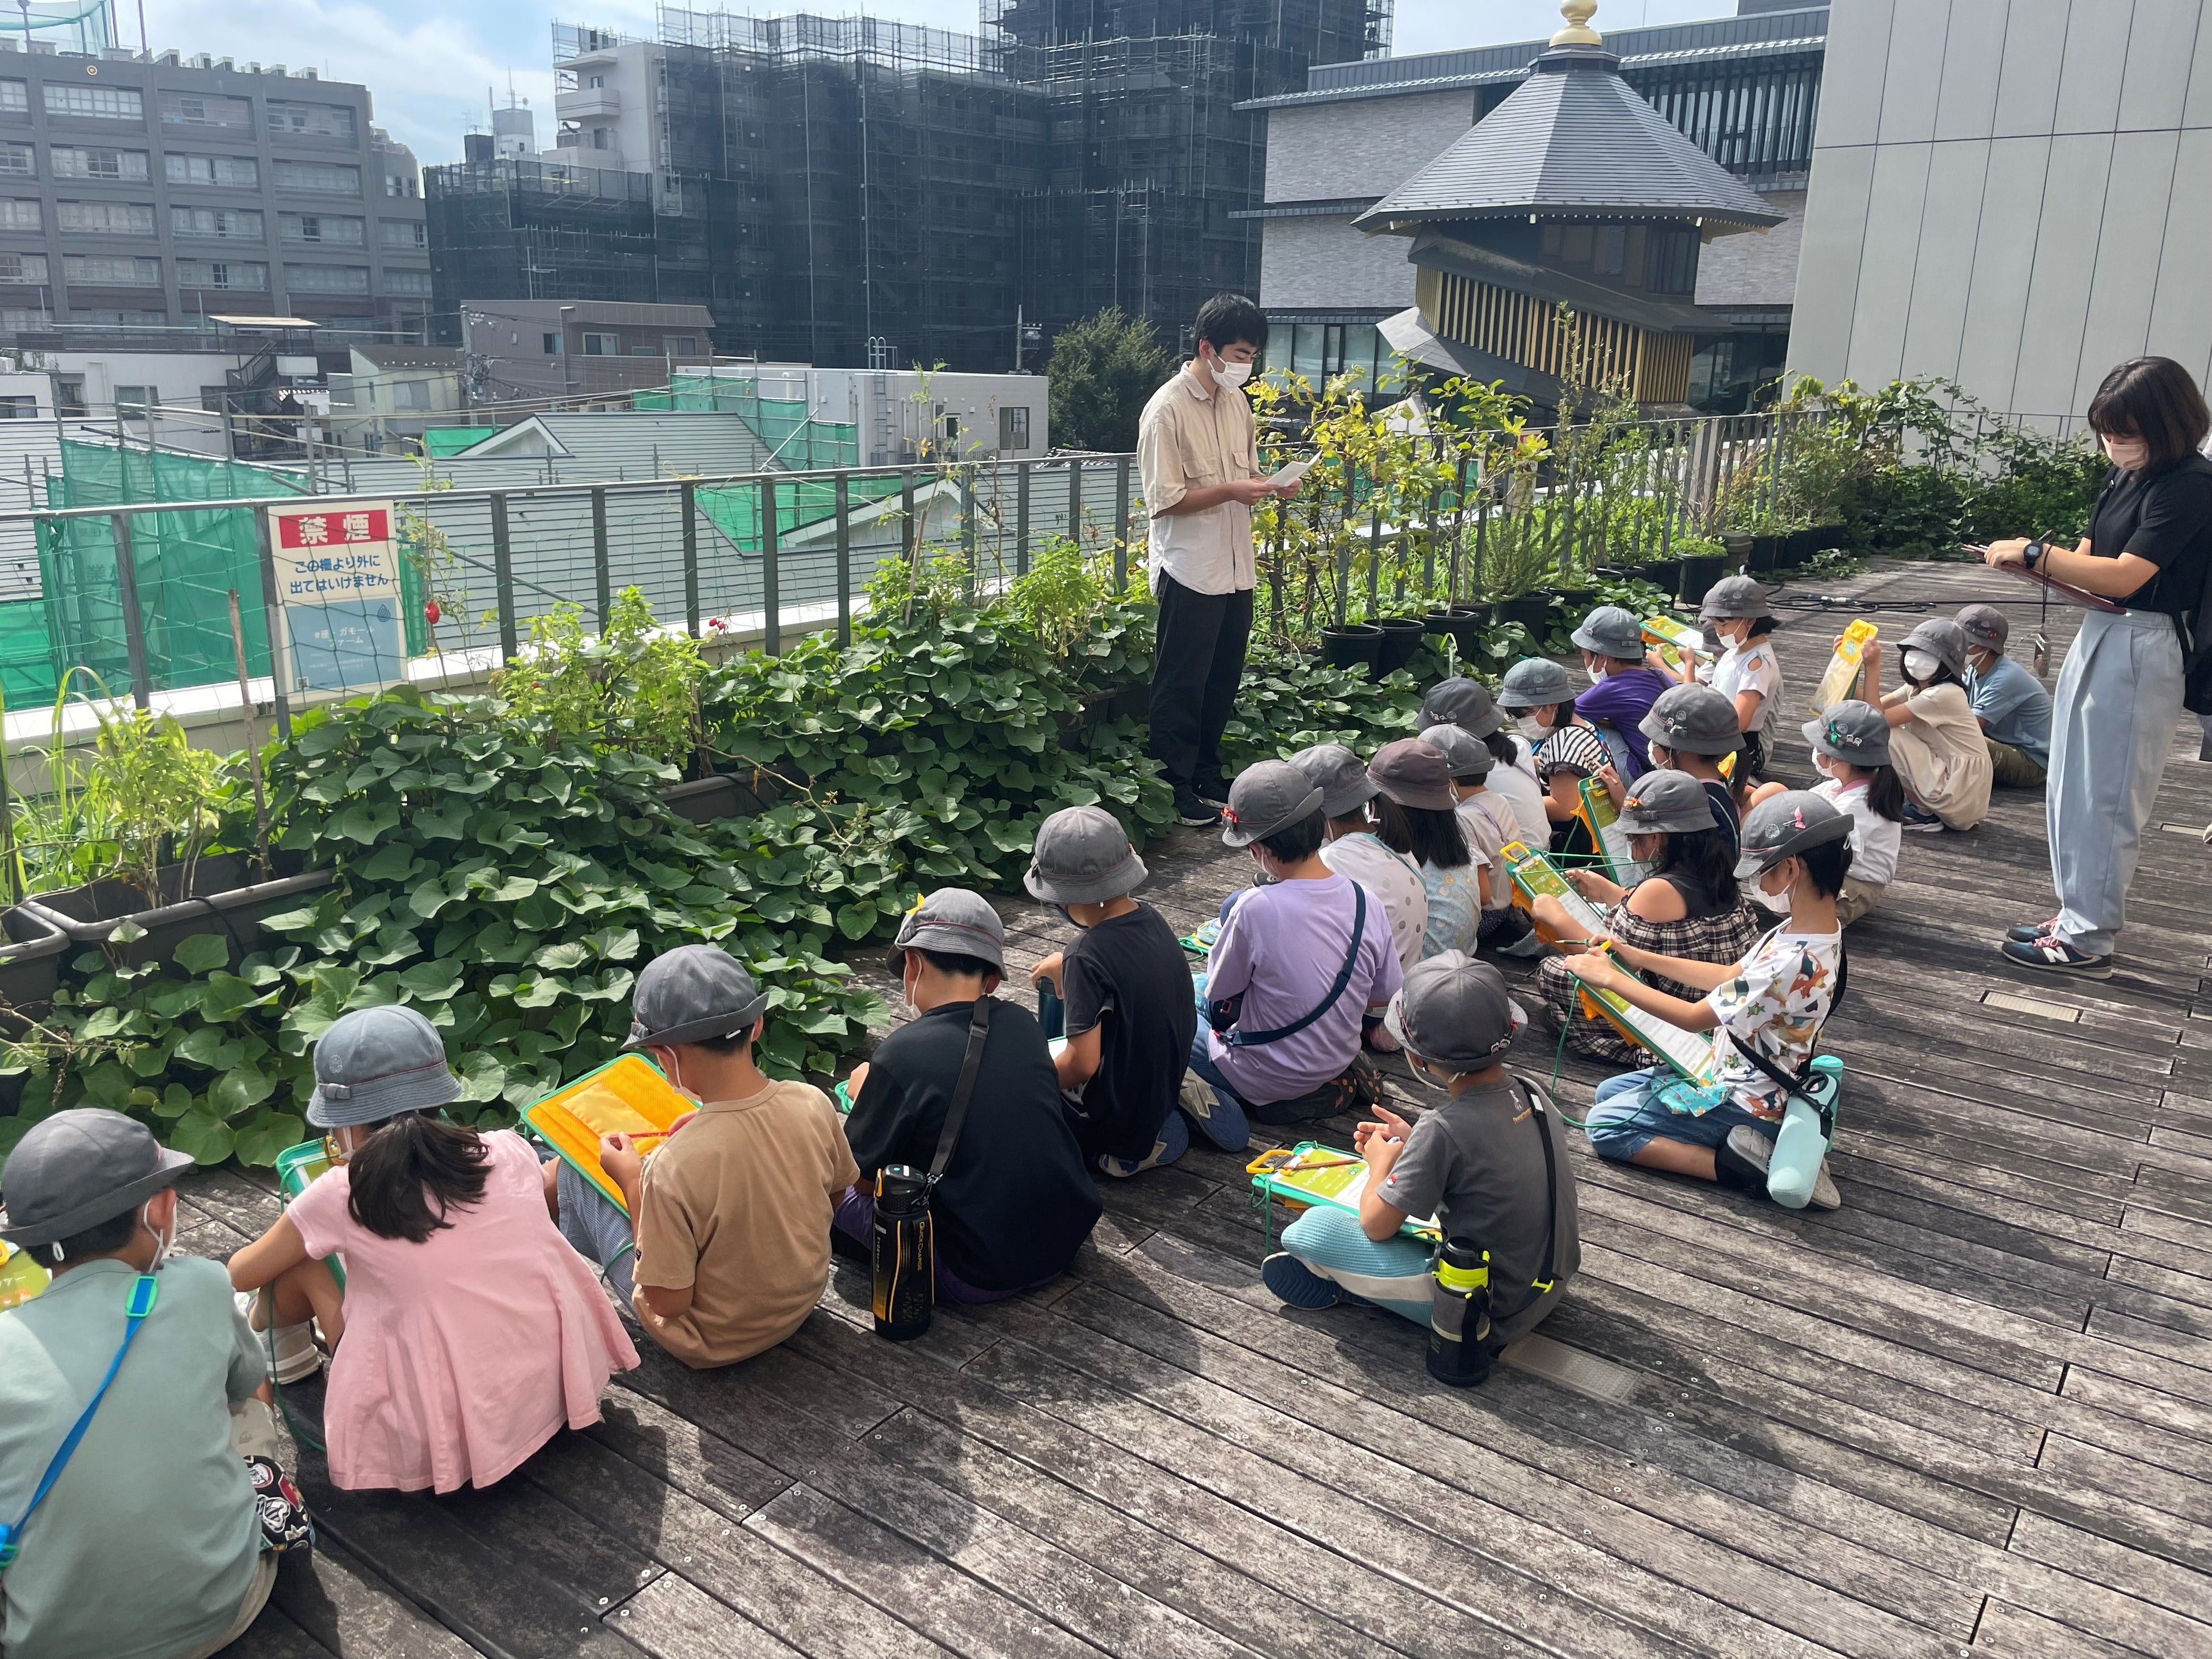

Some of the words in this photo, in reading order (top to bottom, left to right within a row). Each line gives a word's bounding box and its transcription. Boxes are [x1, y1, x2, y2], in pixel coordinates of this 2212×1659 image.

[299, 514, 371, 545] 禁煙
[295, 555, 381, 573] この柵より外に
[290, 573, 389, 594] 出てはいけません
[2042, 945, 2070, 963] N
